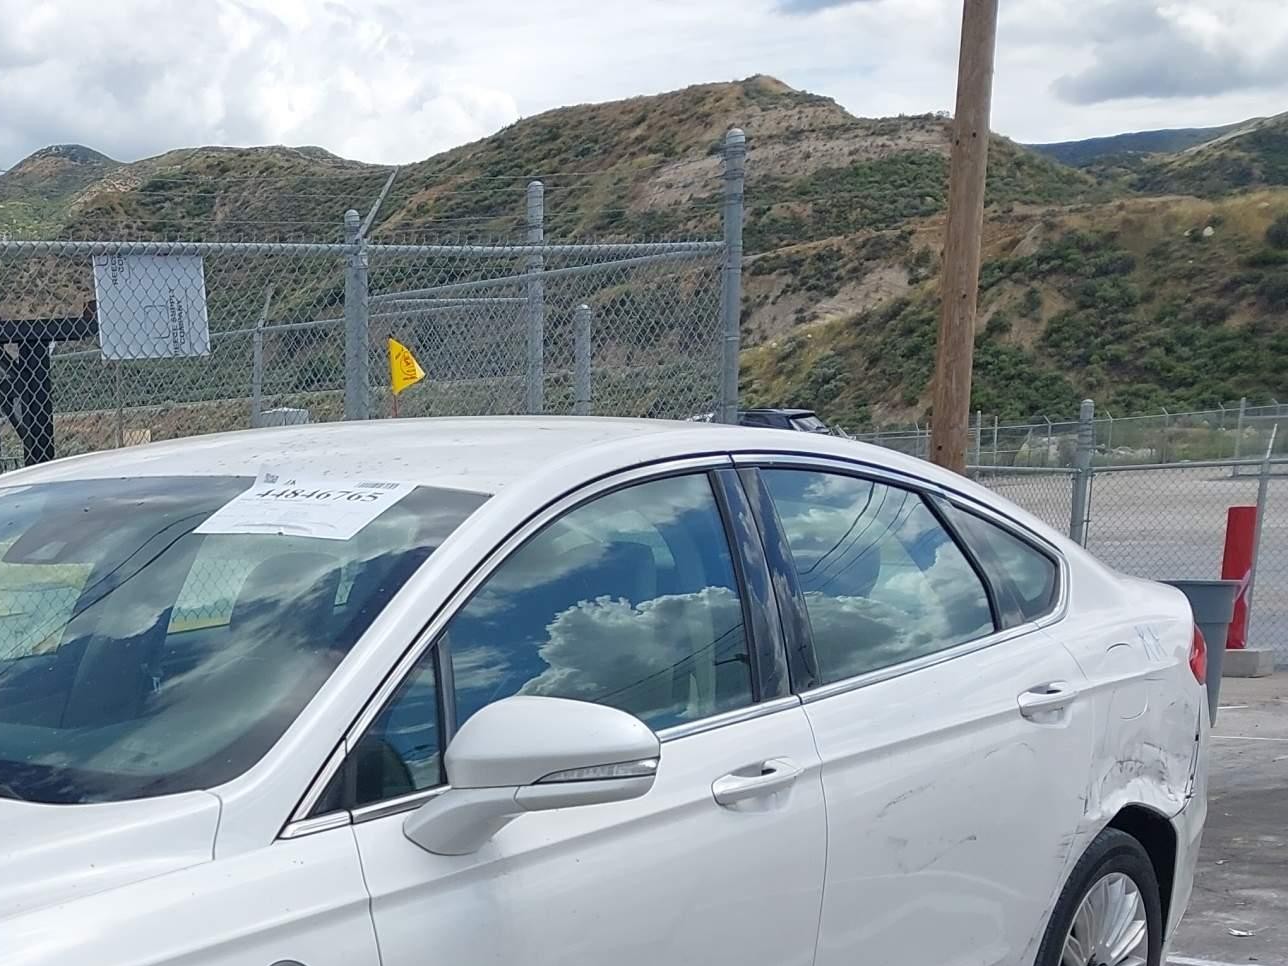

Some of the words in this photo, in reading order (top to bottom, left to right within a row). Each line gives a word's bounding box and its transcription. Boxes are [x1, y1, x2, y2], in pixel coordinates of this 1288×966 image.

[169, 289, 177, 322] SUPPLY
[177, 300, 185, 345] COMPANY
[256, 488, 384, 502] 44846765
